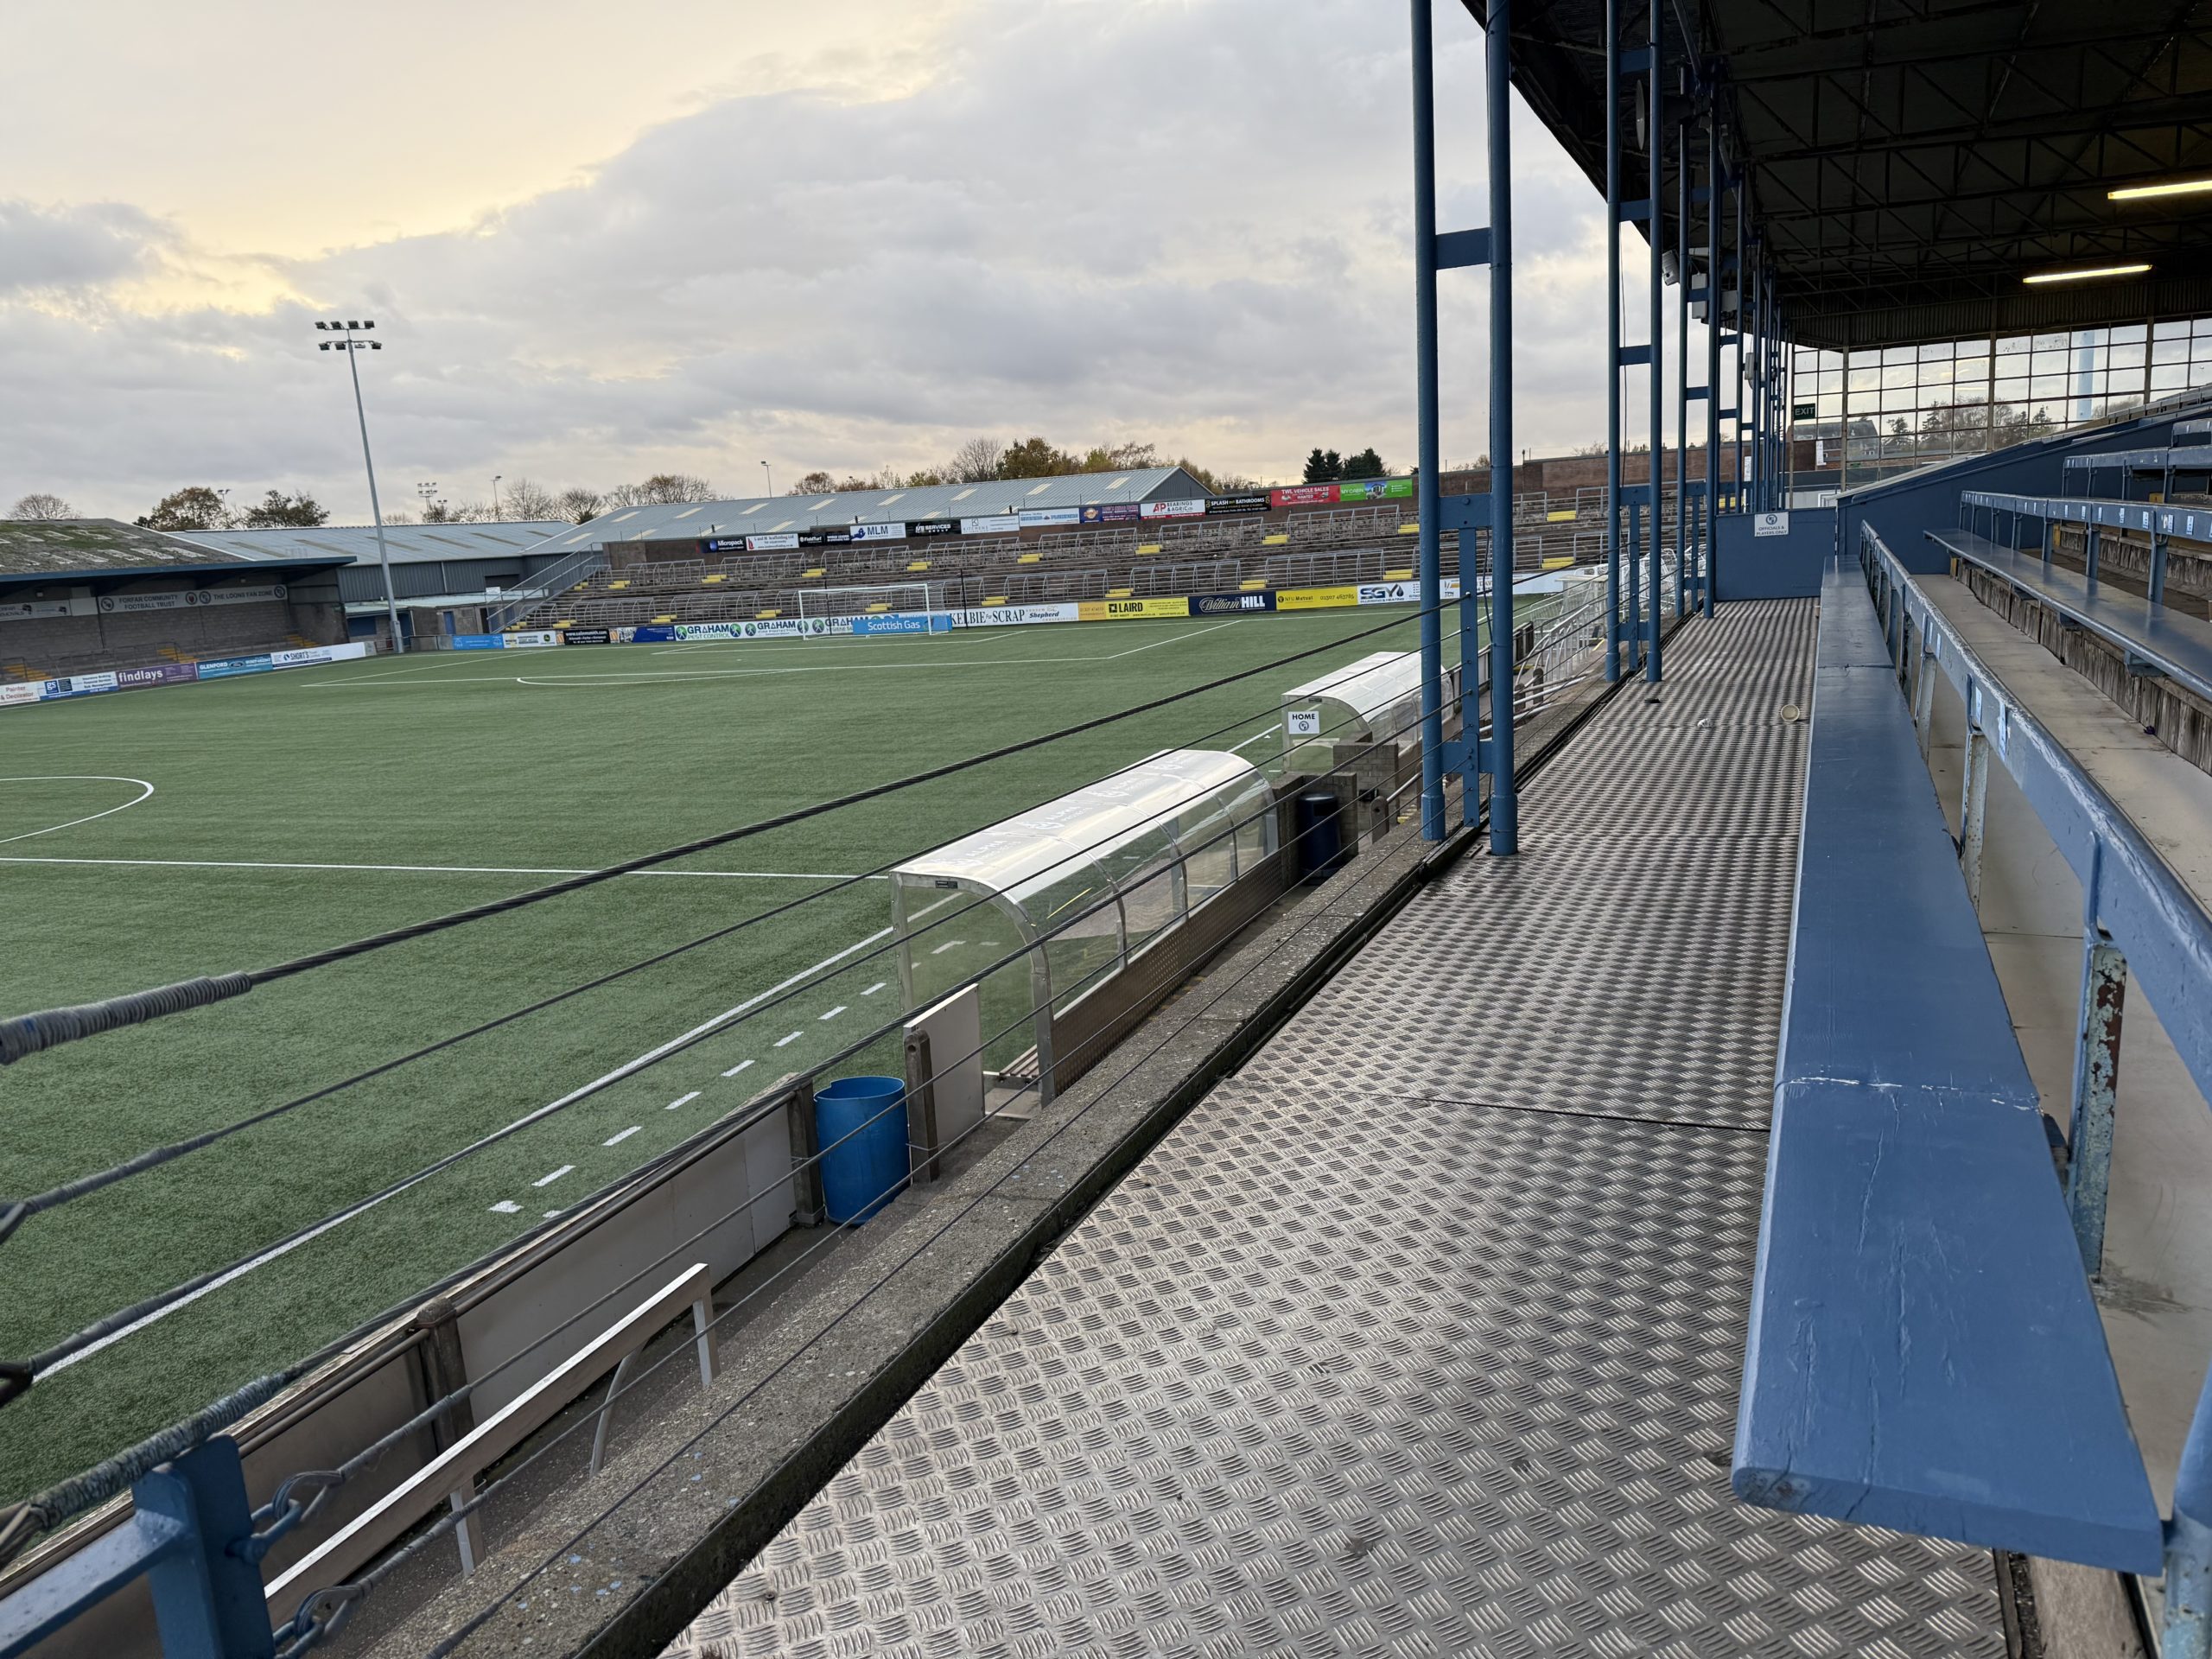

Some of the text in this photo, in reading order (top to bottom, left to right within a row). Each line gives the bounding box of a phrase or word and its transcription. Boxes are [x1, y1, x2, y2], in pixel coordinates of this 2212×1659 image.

[1795, 407, 1815, 416] EXIT
[1153, 503, 1166, 512] AP
[867, 525, 888, 535] MLM
[717, 537, 744, 547] Micropack
[1360, 584, 1397, 599] SGY
[1118, 602, 1143, 613] LAIRD
[1198, 597, 1241, 613] William
[1241, 595, 1266, 608] HILL
[950, 612, 986, 625] KELBIE
[992, 609, 1026, 623] SCRAP
[687, 624, 729, 634] GRAHAM
[757, 620, 796, 630] GRAHAM
[868, 620, 920, 632] Scottish Gas
[199, 661, 228, 670] GLENFORD
[118, 670, 163, 683] findlays
[47, 682, 57, 690] gs
